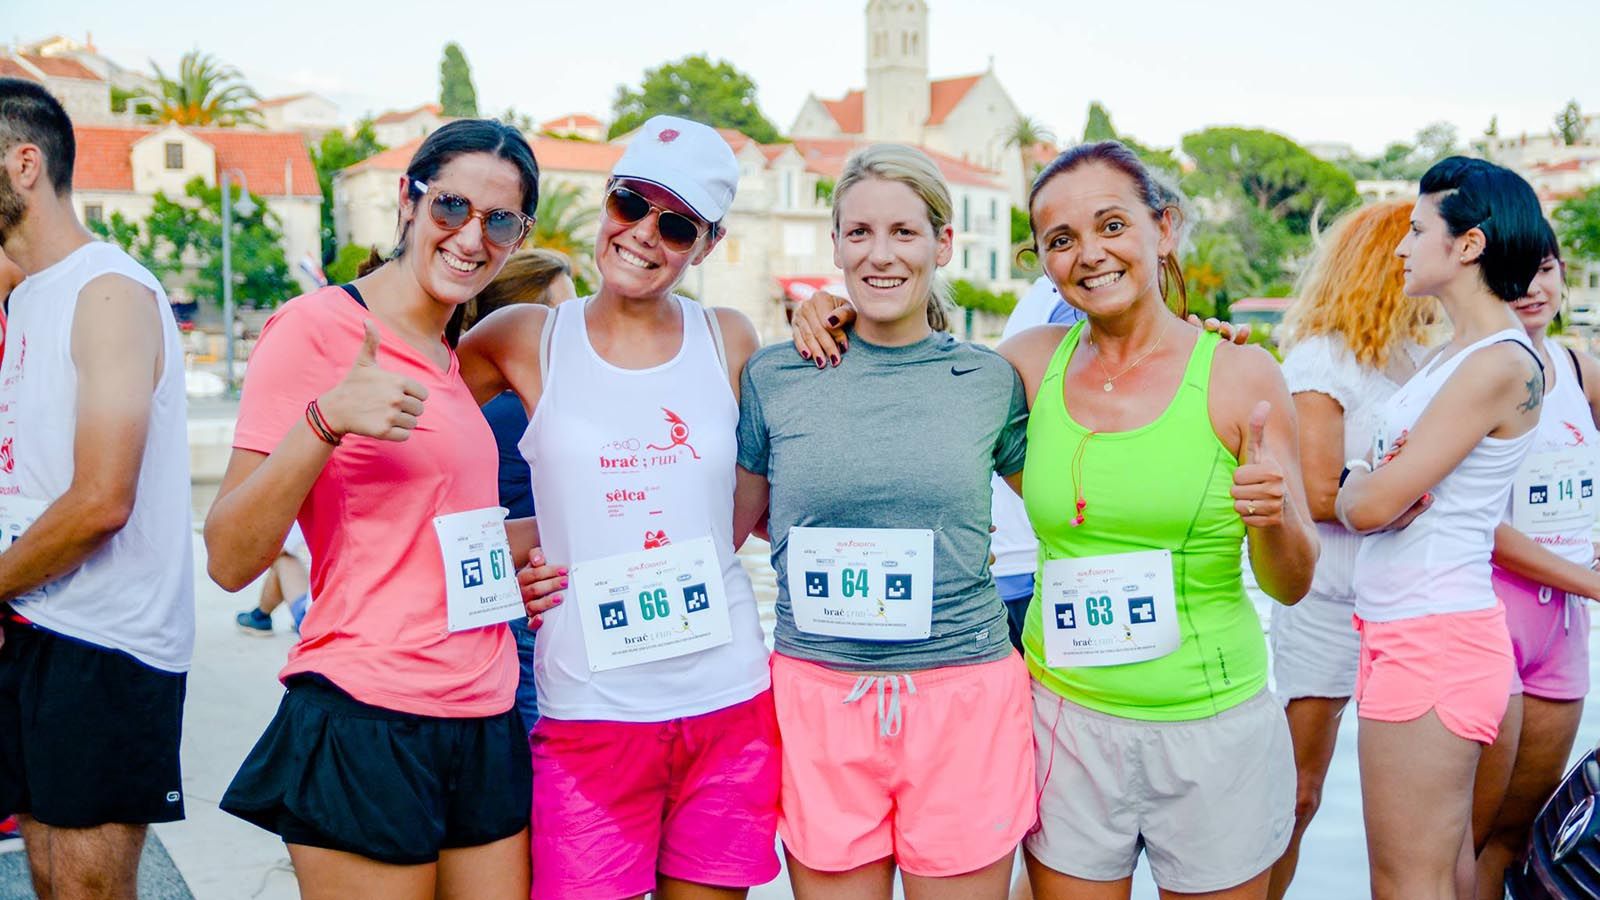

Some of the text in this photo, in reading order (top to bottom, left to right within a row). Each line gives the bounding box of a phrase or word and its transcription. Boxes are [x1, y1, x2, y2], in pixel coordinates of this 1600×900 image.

[600, 454, 639, 468] brač
[606, 489, 646, 502] sêlca
[1558, 479, 1573, 500] 14
[490, 548, 506, 580] 67
[842, 568, 869, 598] 64
[638, 587, 671, 621] 66
[1085, 595, 1114, 626] 63
